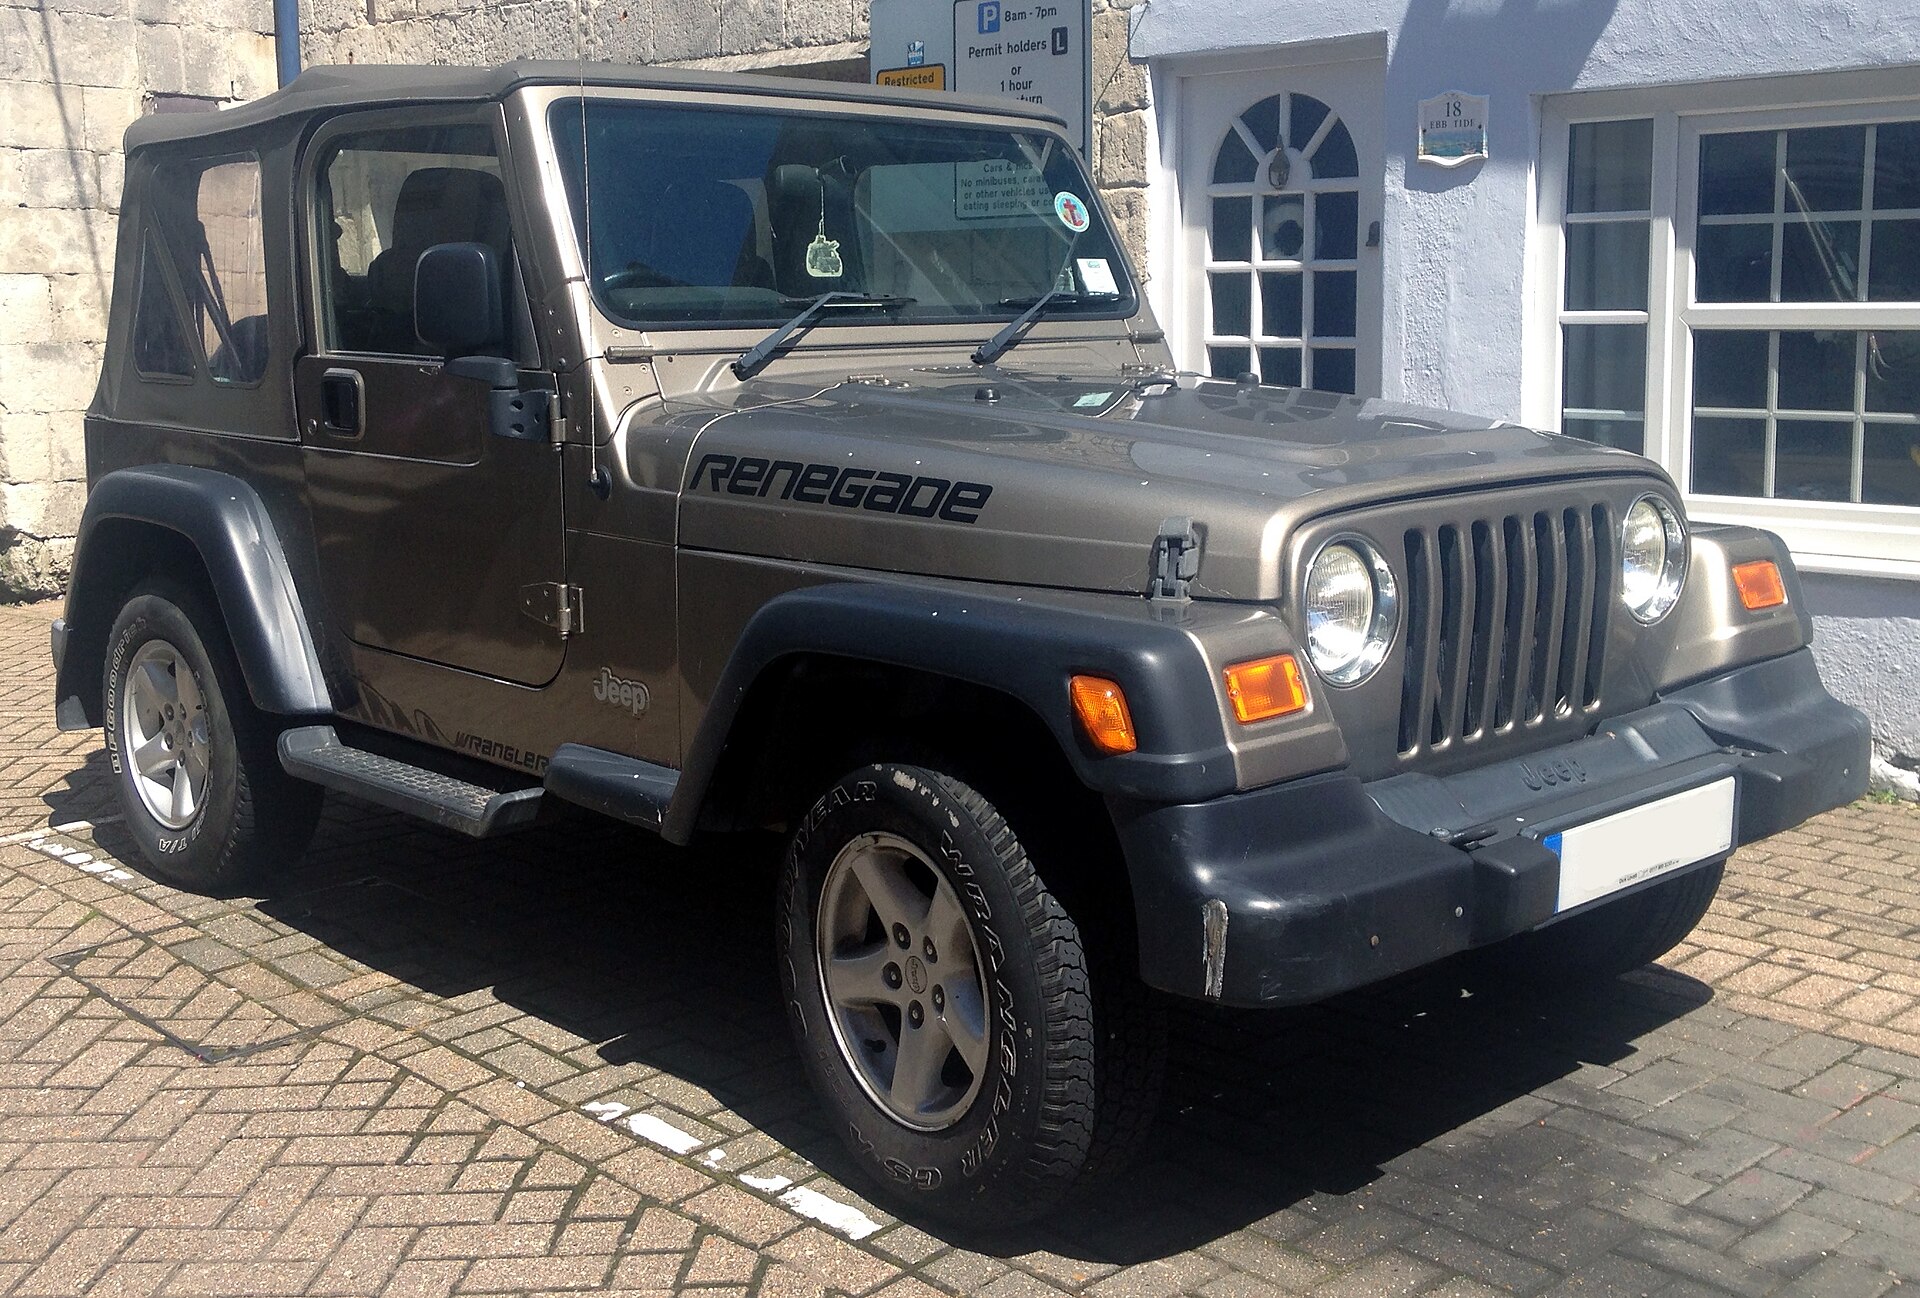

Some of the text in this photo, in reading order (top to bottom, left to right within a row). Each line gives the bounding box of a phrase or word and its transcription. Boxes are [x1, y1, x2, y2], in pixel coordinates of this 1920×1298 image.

[1004, 10, 1027, 22] 8am
[1036, 6, 1057, 20] 7pm
[968, 44, 1003, 59] Permit
[1006, 39, 1047, 54] holders
[1011, 65, 1022, 76] or
[884, 72, 935, 87] Restricted
[1000, 80, 1033, 92] 1 hour
[1446, 101, 1462, 117] 18
[1430, 120, 1448, 129] EBB
[983, 163, 1003, 173] Cars
[960, 178, 973, 188] No
[975, 190, 998, 199] other
[1000, 187, 1036, 198] vehicles
[963, 200, 989, 211] eating
[992, 199, 1028, 210] sleeping
[1031, 199, 1040, 207] or
[593, 666, 651, 718] Jeep
[1519, 758, 1588, 792] Jeep
